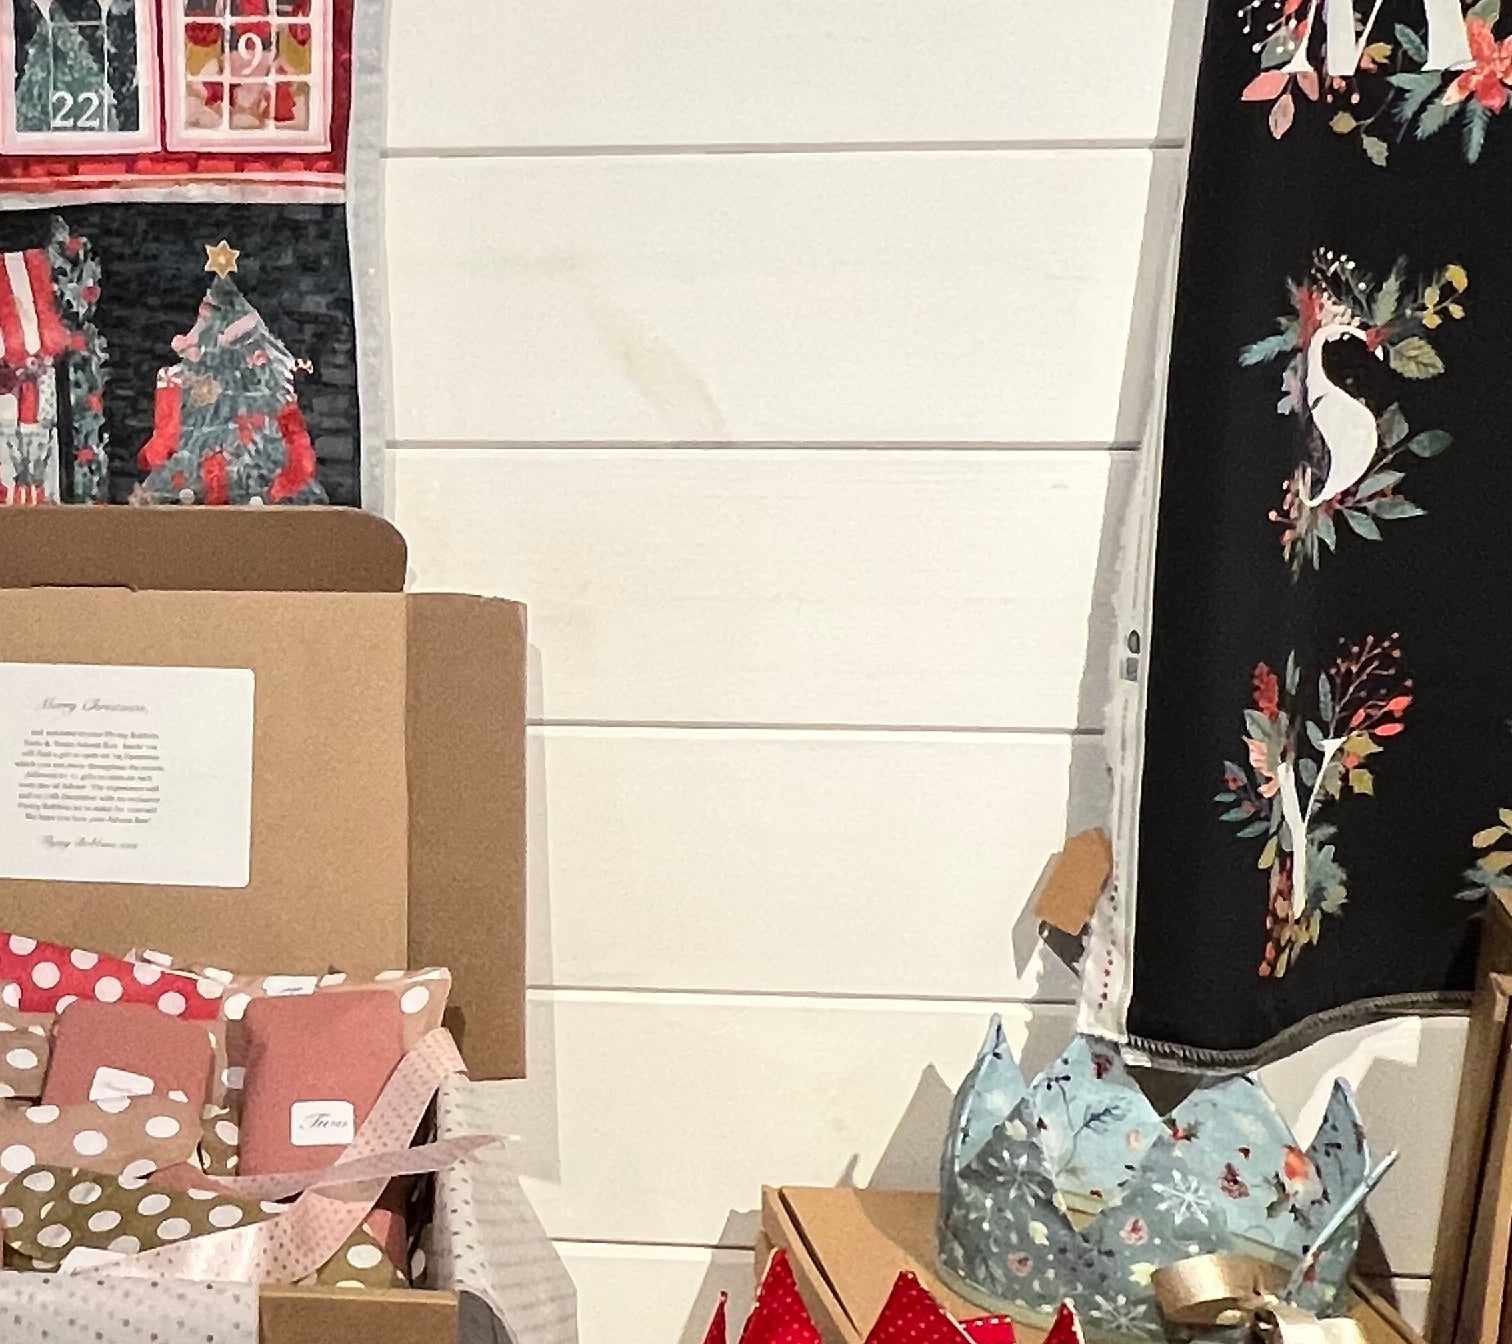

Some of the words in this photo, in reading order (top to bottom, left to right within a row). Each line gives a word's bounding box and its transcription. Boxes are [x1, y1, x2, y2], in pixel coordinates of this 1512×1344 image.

[237, 32, 264, 76] 9
[51, 91, 101, 129] 22
[1299, 321, 1385, 509] S
